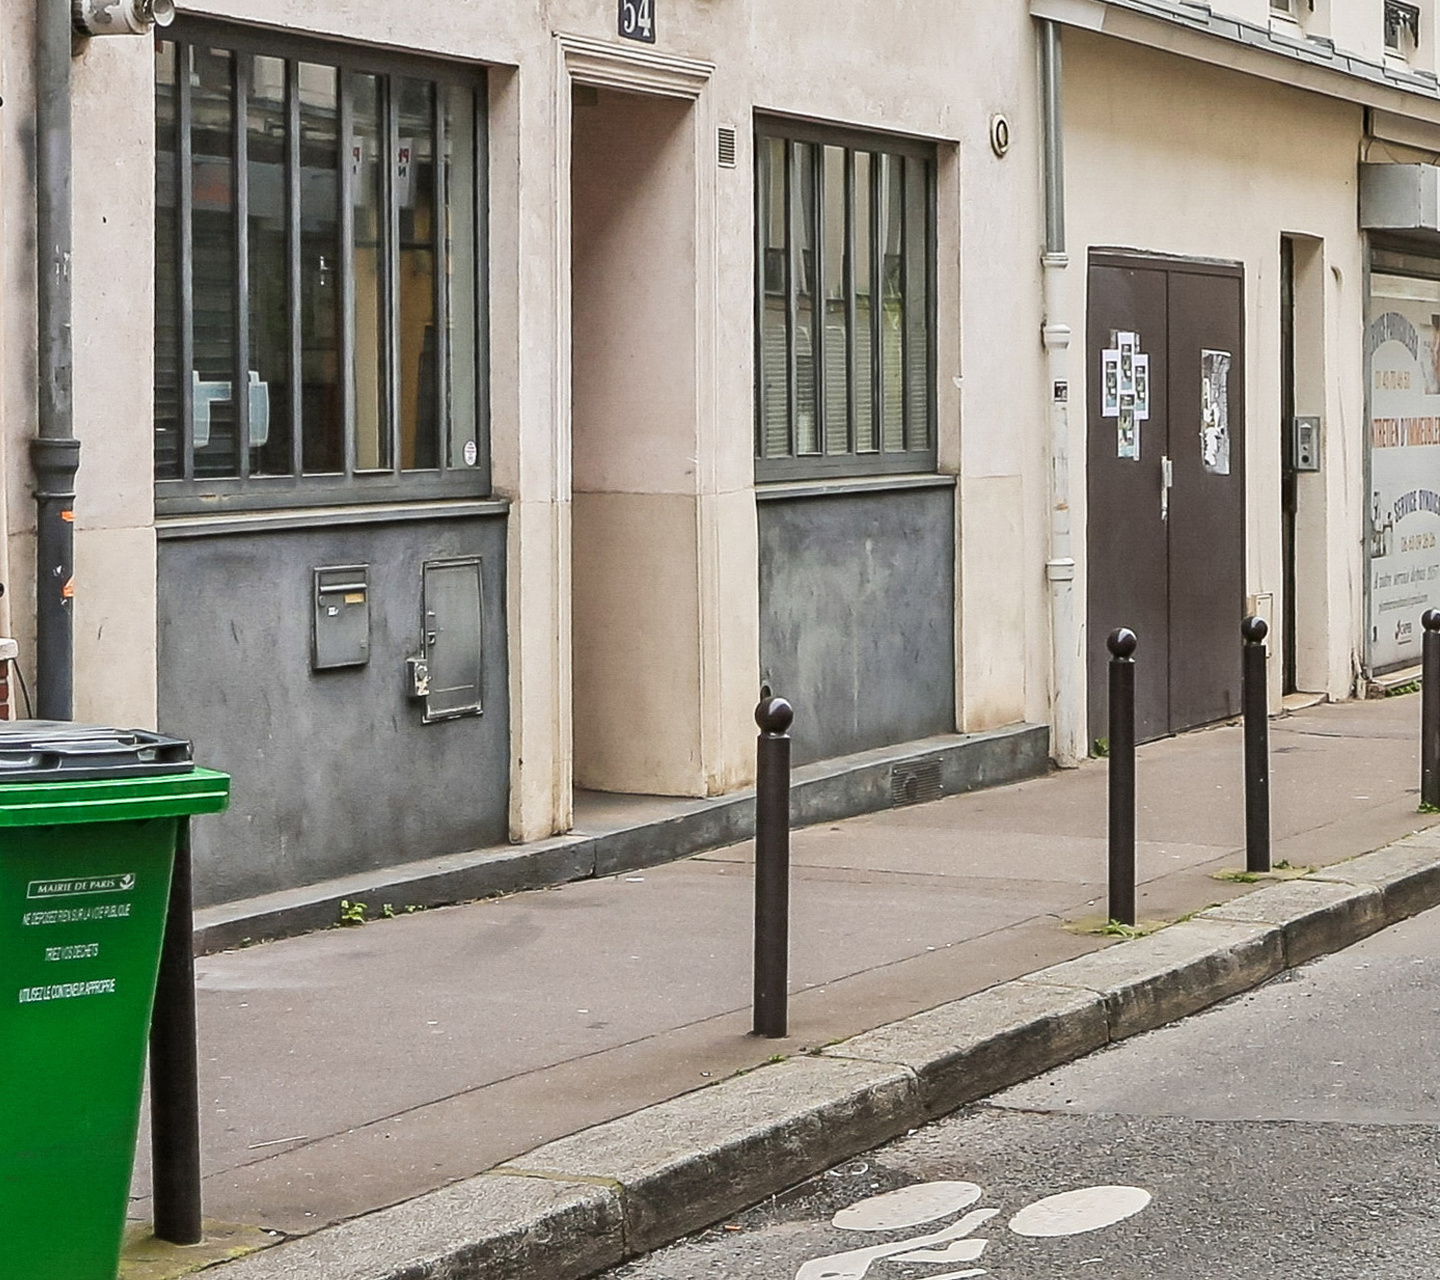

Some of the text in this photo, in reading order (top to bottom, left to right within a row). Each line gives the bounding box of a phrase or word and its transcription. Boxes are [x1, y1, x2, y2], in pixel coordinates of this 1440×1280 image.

[37, 879, 116, 894] MAIRIE DE PARIS
[43, 985, 52, 1000] LE
[51, 981, 86, 1000] CONTENEUR
